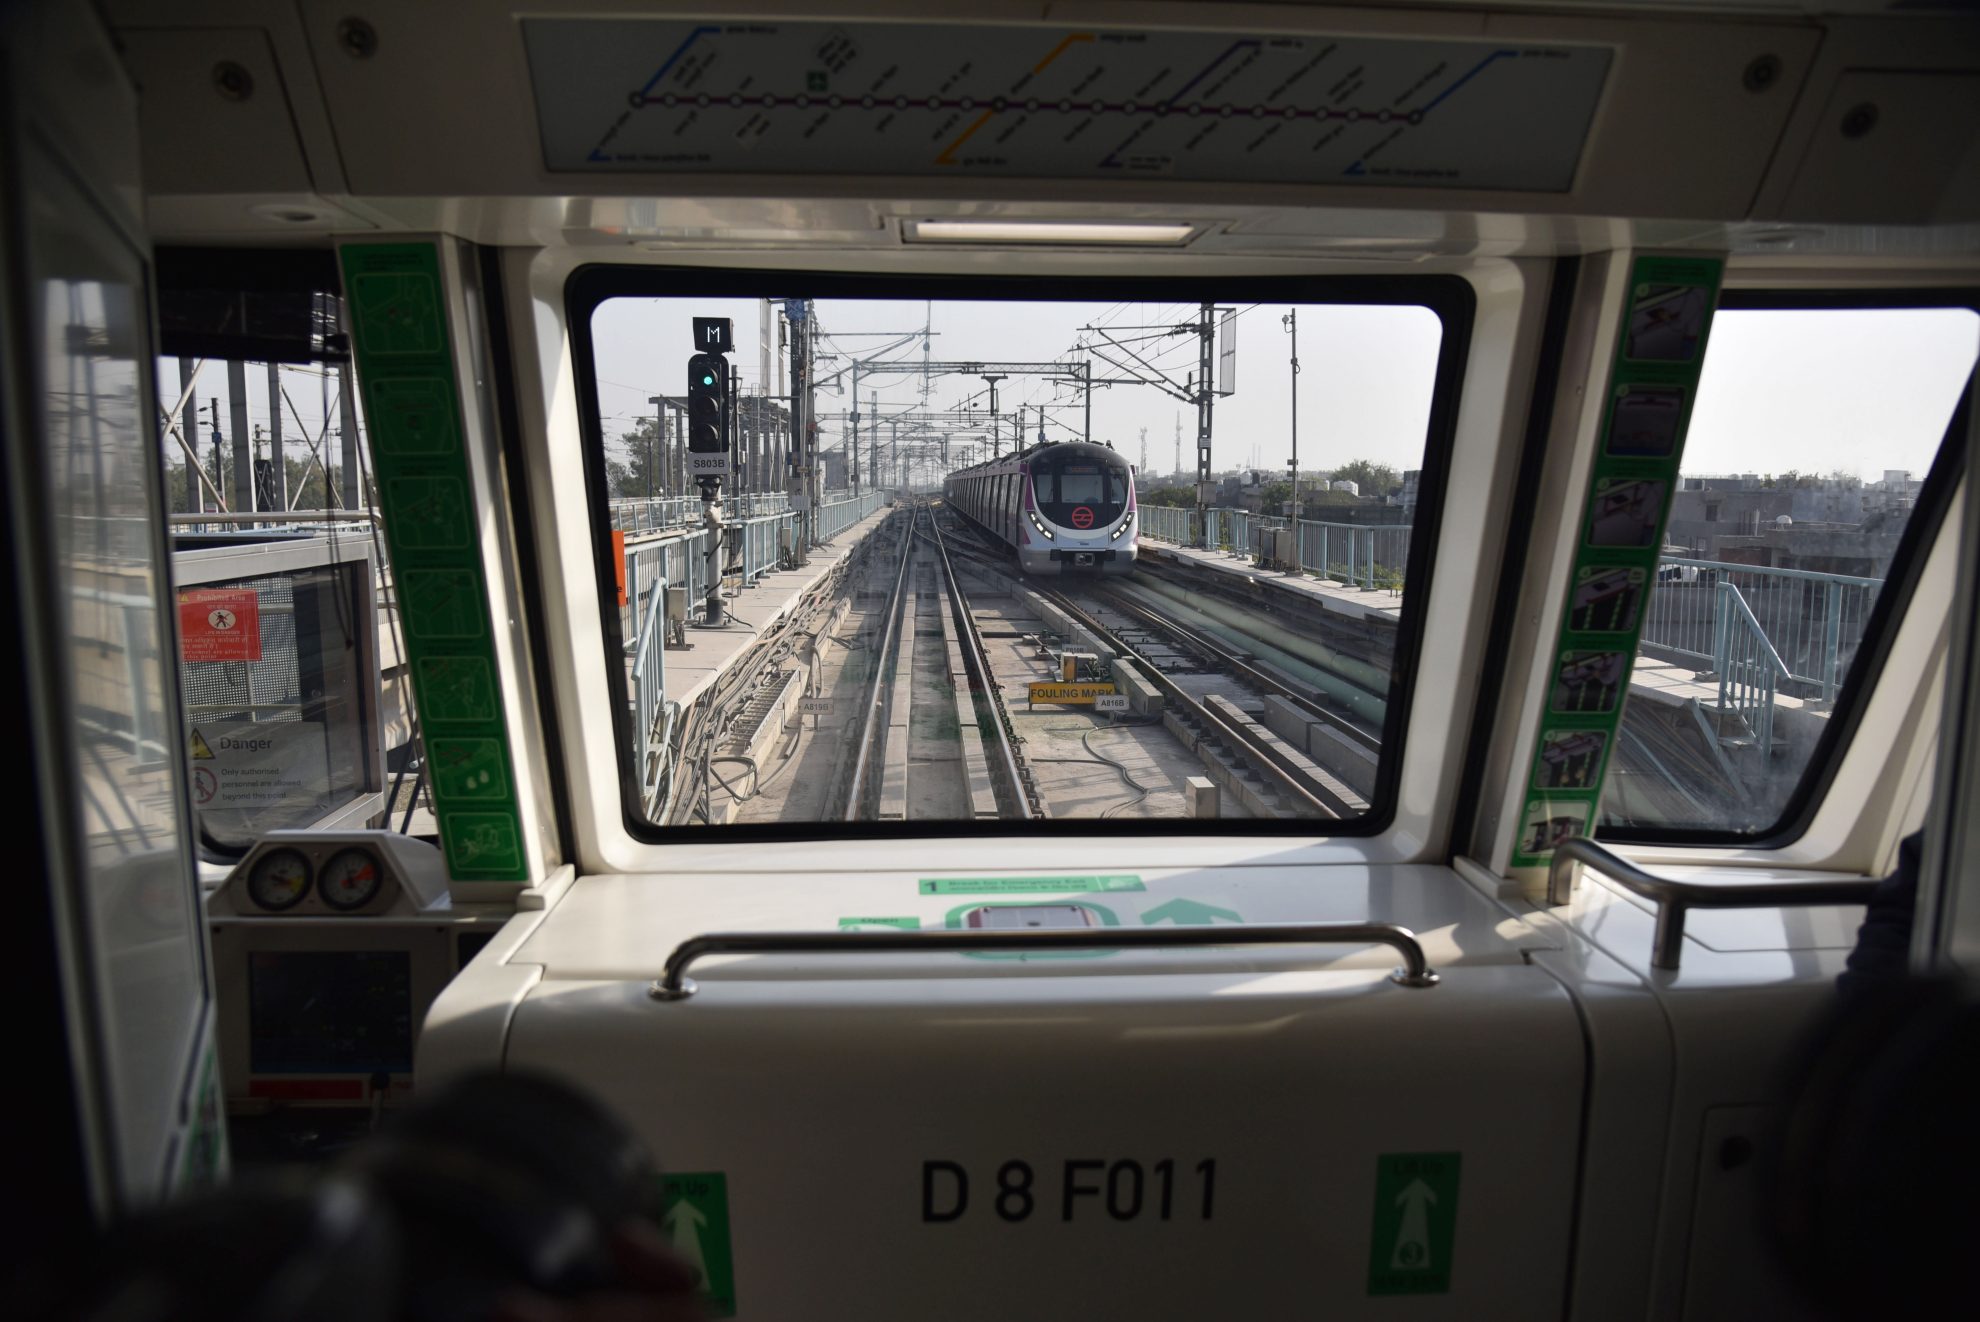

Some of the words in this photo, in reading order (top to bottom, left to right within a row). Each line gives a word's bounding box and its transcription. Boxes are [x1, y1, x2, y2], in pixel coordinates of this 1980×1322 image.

[707, 326, 720, 343] M
[693, 459, 725, 469] S803B
[1031, 689, 1078, 698] FOULING
[1081, 689, 1113, 698] MARK
[1101, 699, 1125, 707] A816B
[220, 737, 273, 752] Danger
[221, 768, 239, 777] Only
[240, 767, 280, 775] authorised
[222, 780, 258, 789] personnel
[222, 792, 251, 802] beyond
[252, 792, 266, 800] this
[922, 1159, 969, 1224] D
[994, 1159, 1034, 1222] 8
[1061, 1157, 1217, 1222] F011
